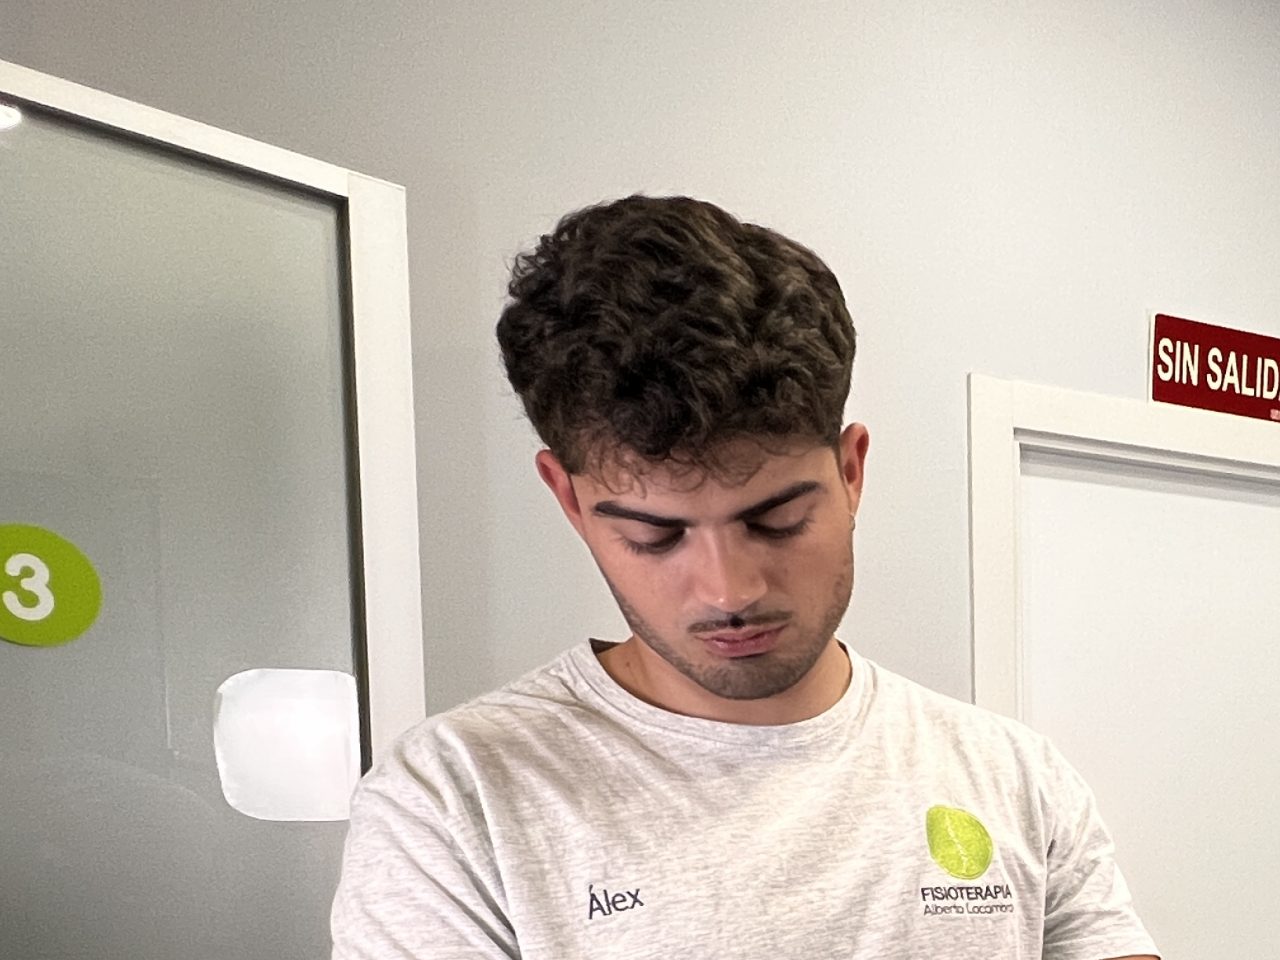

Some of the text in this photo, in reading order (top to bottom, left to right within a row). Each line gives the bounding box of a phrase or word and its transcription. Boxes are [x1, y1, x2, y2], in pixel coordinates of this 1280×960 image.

[1157, 337, 1199, 386] SIN
[2, 552, 55, 621] 3
[588, 884, 645, 920] Álex
[920, 884, 1013, 902] FISIOTERAPIA
[923, 903, 965, 916] Alberto
